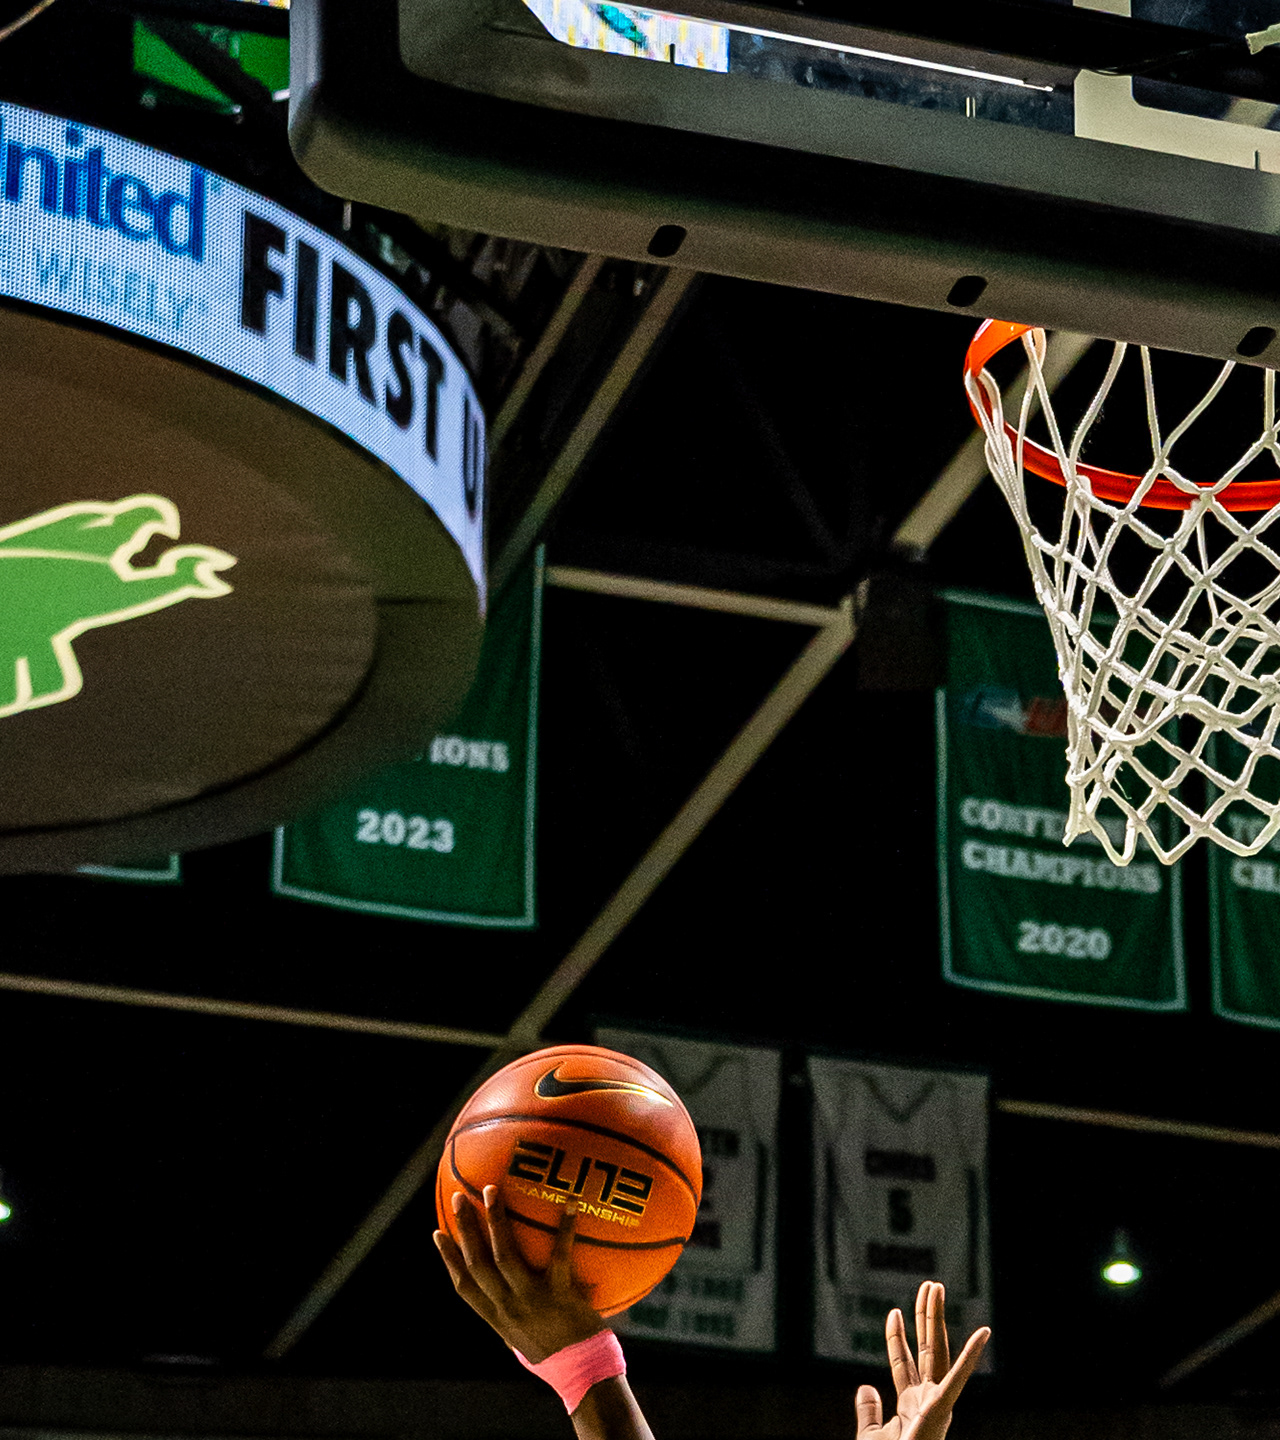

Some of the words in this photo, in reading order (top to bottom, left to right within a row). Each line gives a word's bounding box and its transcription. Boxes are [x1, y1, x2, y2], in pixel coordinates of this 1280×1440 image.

[35, 242, 192, 331] WISELY
[240, 209, 452, 466] FIRST
[355, 808, 457, 854] 2023
[961, 839, 1162, 895] CHAMPIONS
[1016, 920, 1114, 961] 2020
[507, 1138, 656, 1218] ELITE
[511, 1178, 641, 1228] HAMPONSHIP
